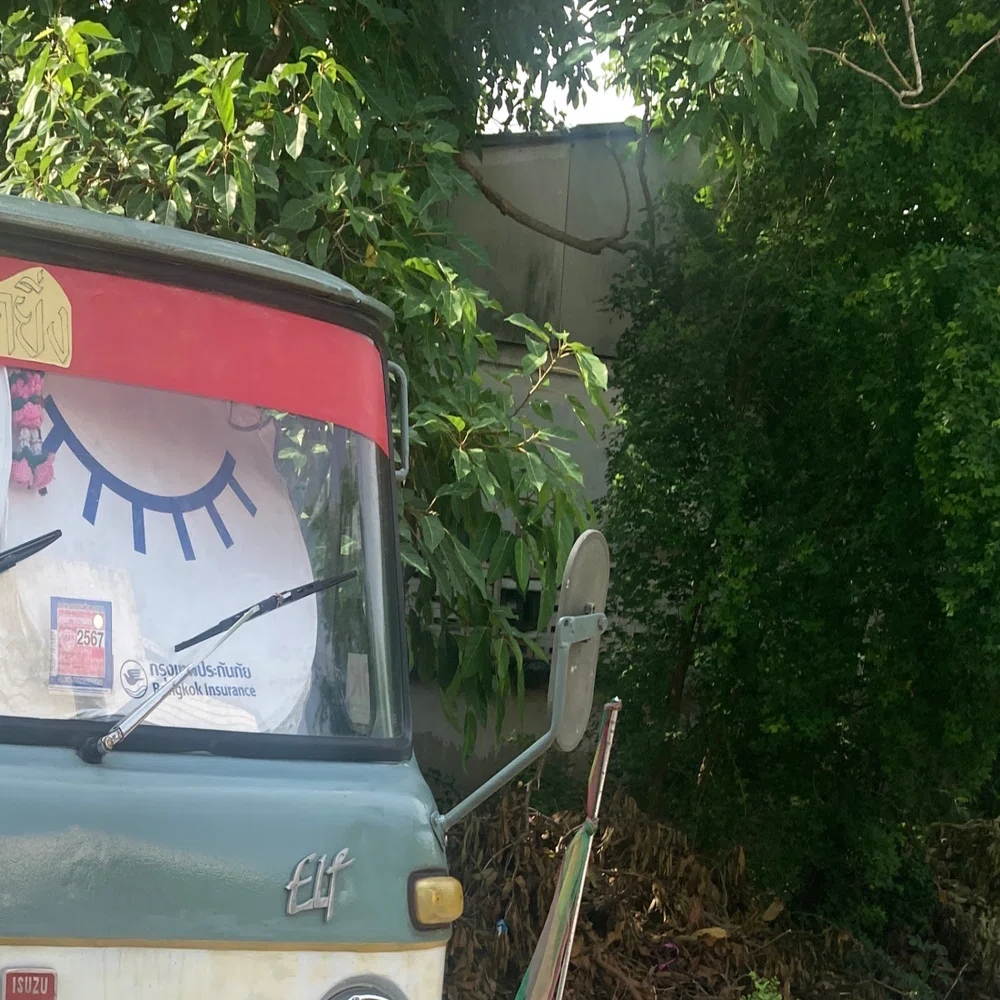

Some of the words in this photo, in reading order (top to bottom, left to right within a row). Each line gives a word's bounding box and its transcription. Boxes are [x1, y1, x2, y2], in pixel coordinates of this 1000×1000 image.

[76, 629, 105, 649] 2567
[152, 681, 204, 700] Bngkok
[204, 683, 257, 697] Insurance
[12, 976, 49, 995] ISUZU
